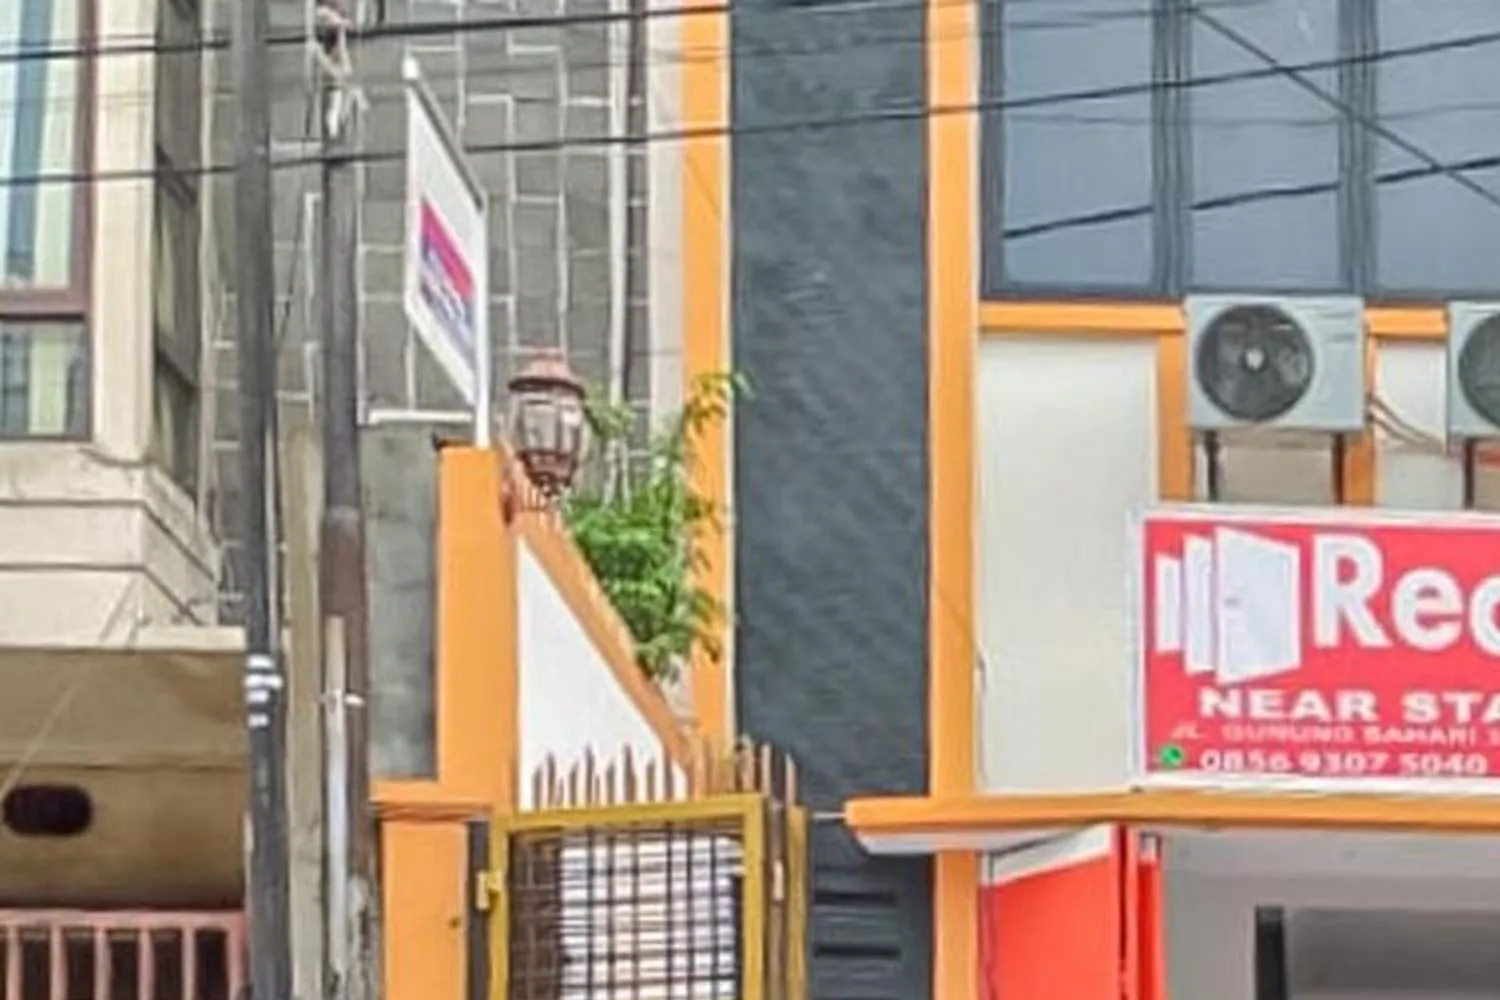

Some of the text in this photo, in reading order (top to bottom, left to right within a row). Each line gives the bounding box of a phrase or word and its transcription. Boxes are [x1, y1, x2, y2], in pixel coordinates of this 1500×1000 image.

[1198, 687, 1379, 722] NEAR
[1200, 749, 1292, 773] 0856
[1299, 750, 1390, 774] 9307
[1398, 752, 1489, 775] 5040
